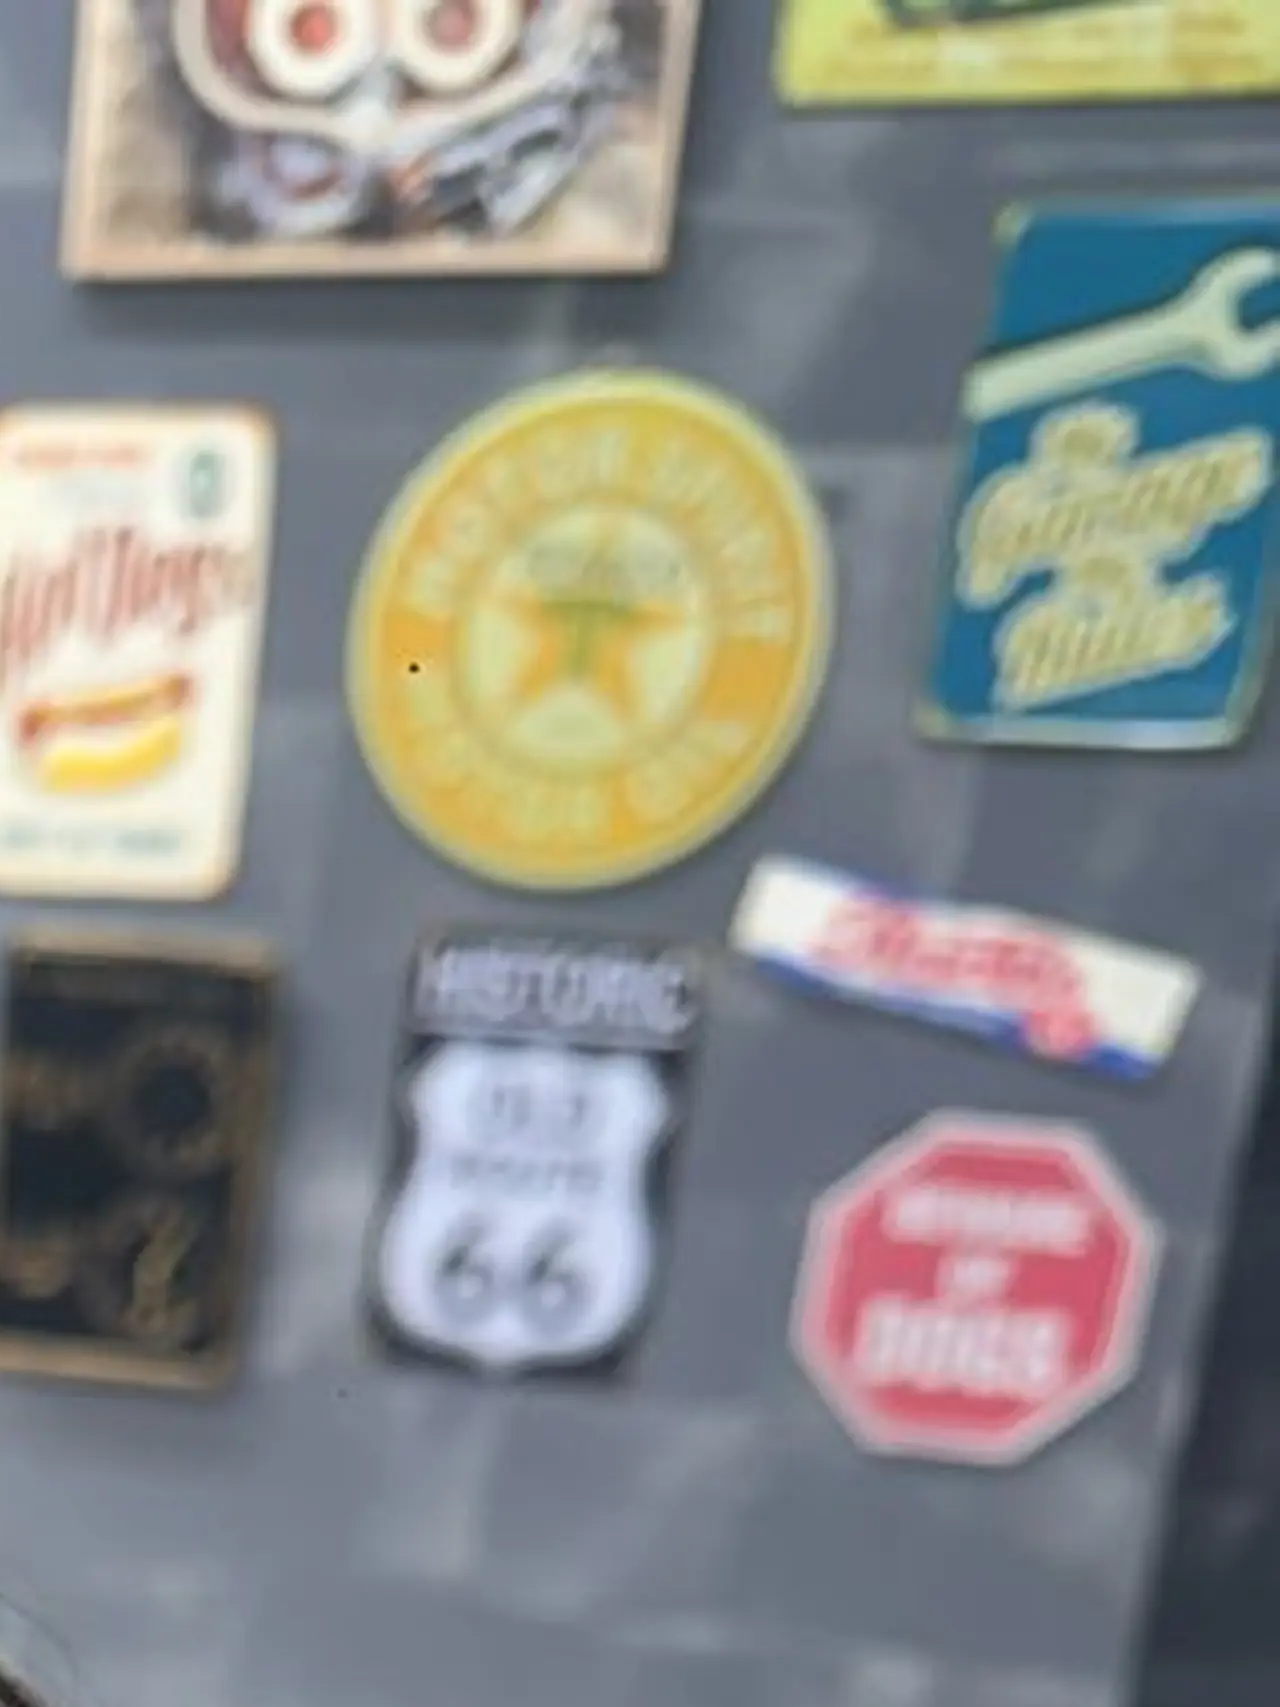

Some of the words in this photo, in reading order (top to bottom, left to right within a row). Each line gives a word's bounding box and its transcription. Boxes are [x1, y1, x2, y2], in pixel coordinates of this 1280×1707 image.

[416, 946, 695, 1034] HISTORIC
[433, 1206, 592, 1332] 66
[855, 1296, 1072, 1394] DOGS
